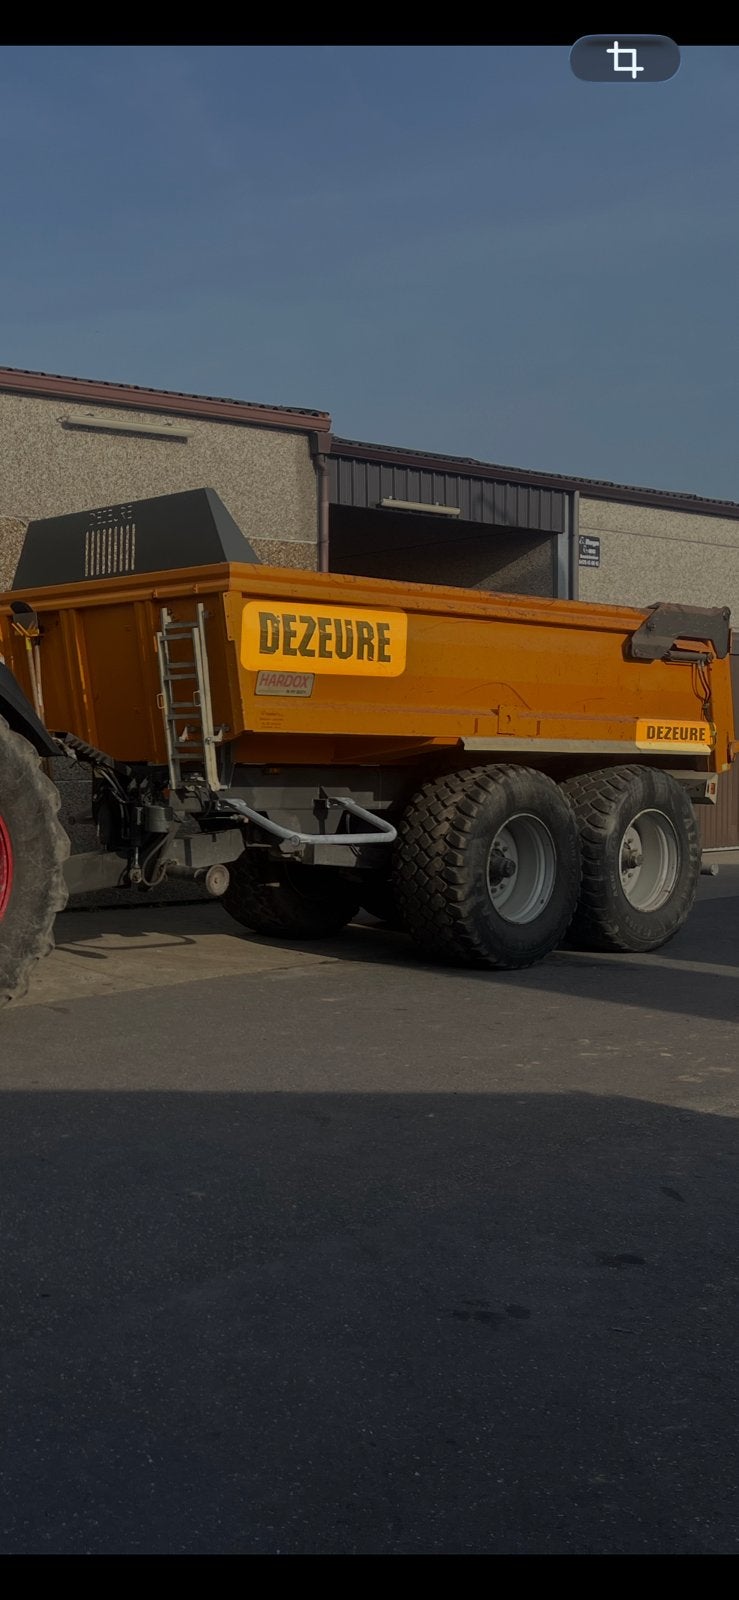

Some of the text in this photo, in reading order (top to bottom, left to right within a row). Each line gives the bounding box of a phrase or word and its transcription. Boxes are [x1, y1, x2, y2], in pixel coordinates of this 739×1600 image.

[258, 611, 392, 663] DEZEURE
[259, 673, 308, 689] HARDOX
[646, 725, 706, 741] DEZEURE
